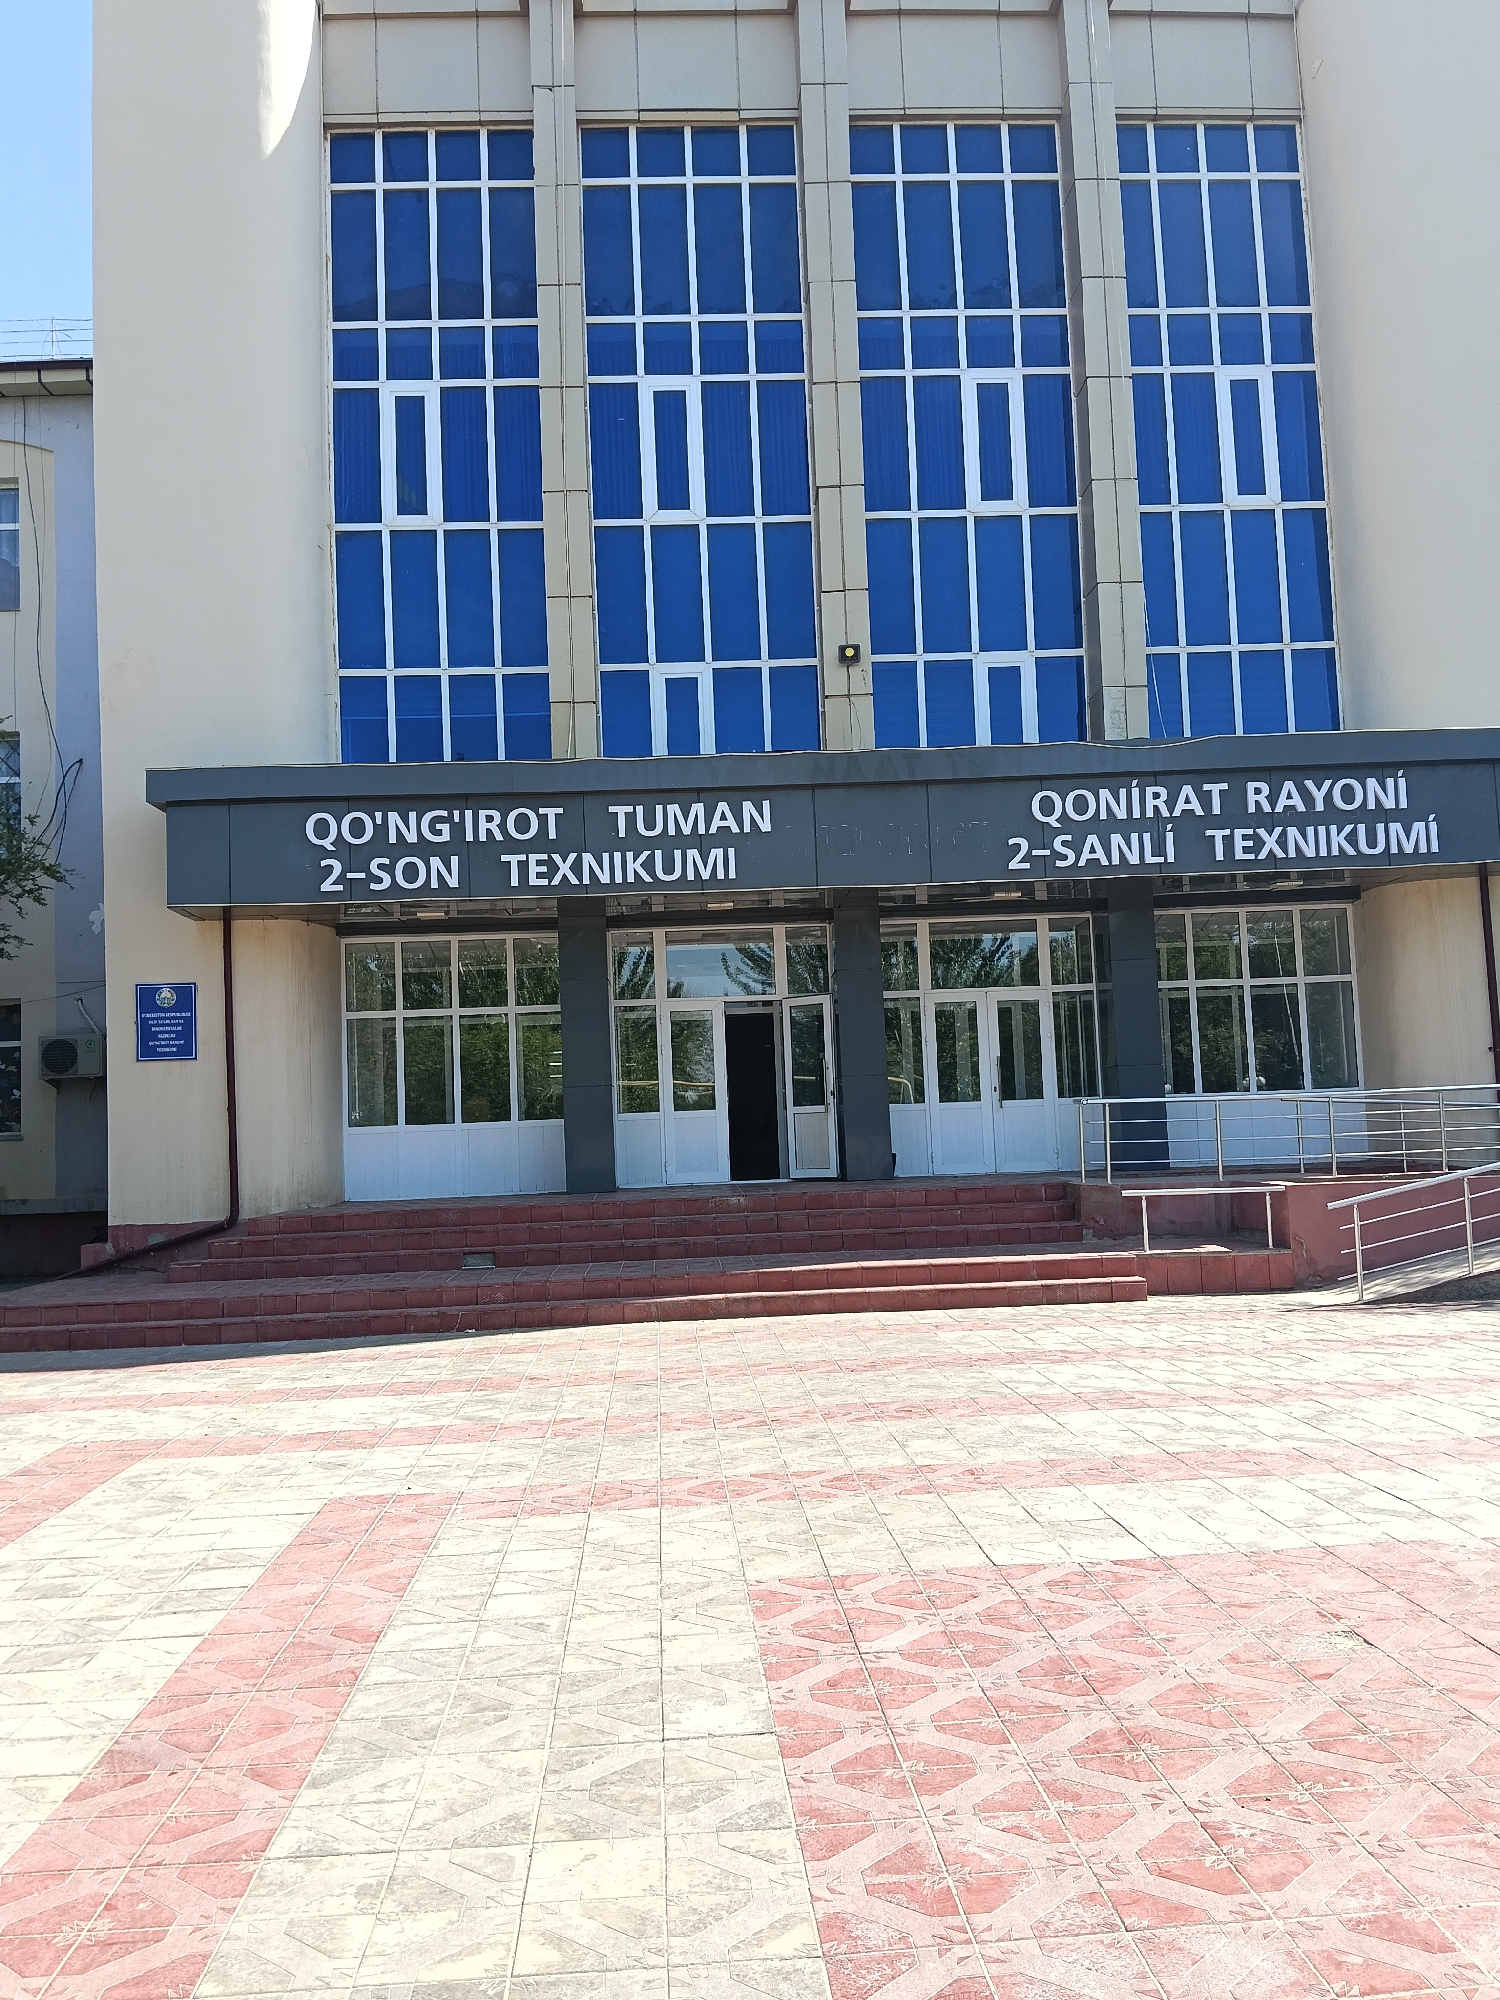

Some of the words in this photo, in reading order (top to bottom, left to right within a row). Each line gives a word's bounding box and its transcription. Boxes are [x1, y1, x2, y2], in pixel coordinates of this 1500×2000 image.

[305, 806, 565, 851] QO'NG'IROT
[608, 799, 773, 839] TUMAN
[1031, 778, 1230, 828] QONÍRAT
[1246, 769, 1409, 815] RAYONÍ
[320, 854, 460, 892] 2-SON
[500, 847, 737, 887] TEXNIKUMI
[1007, 823, 1176, 871] 2-SANLÍ
[1204, 813, 1440, 862] TEXNIKUMÍ
